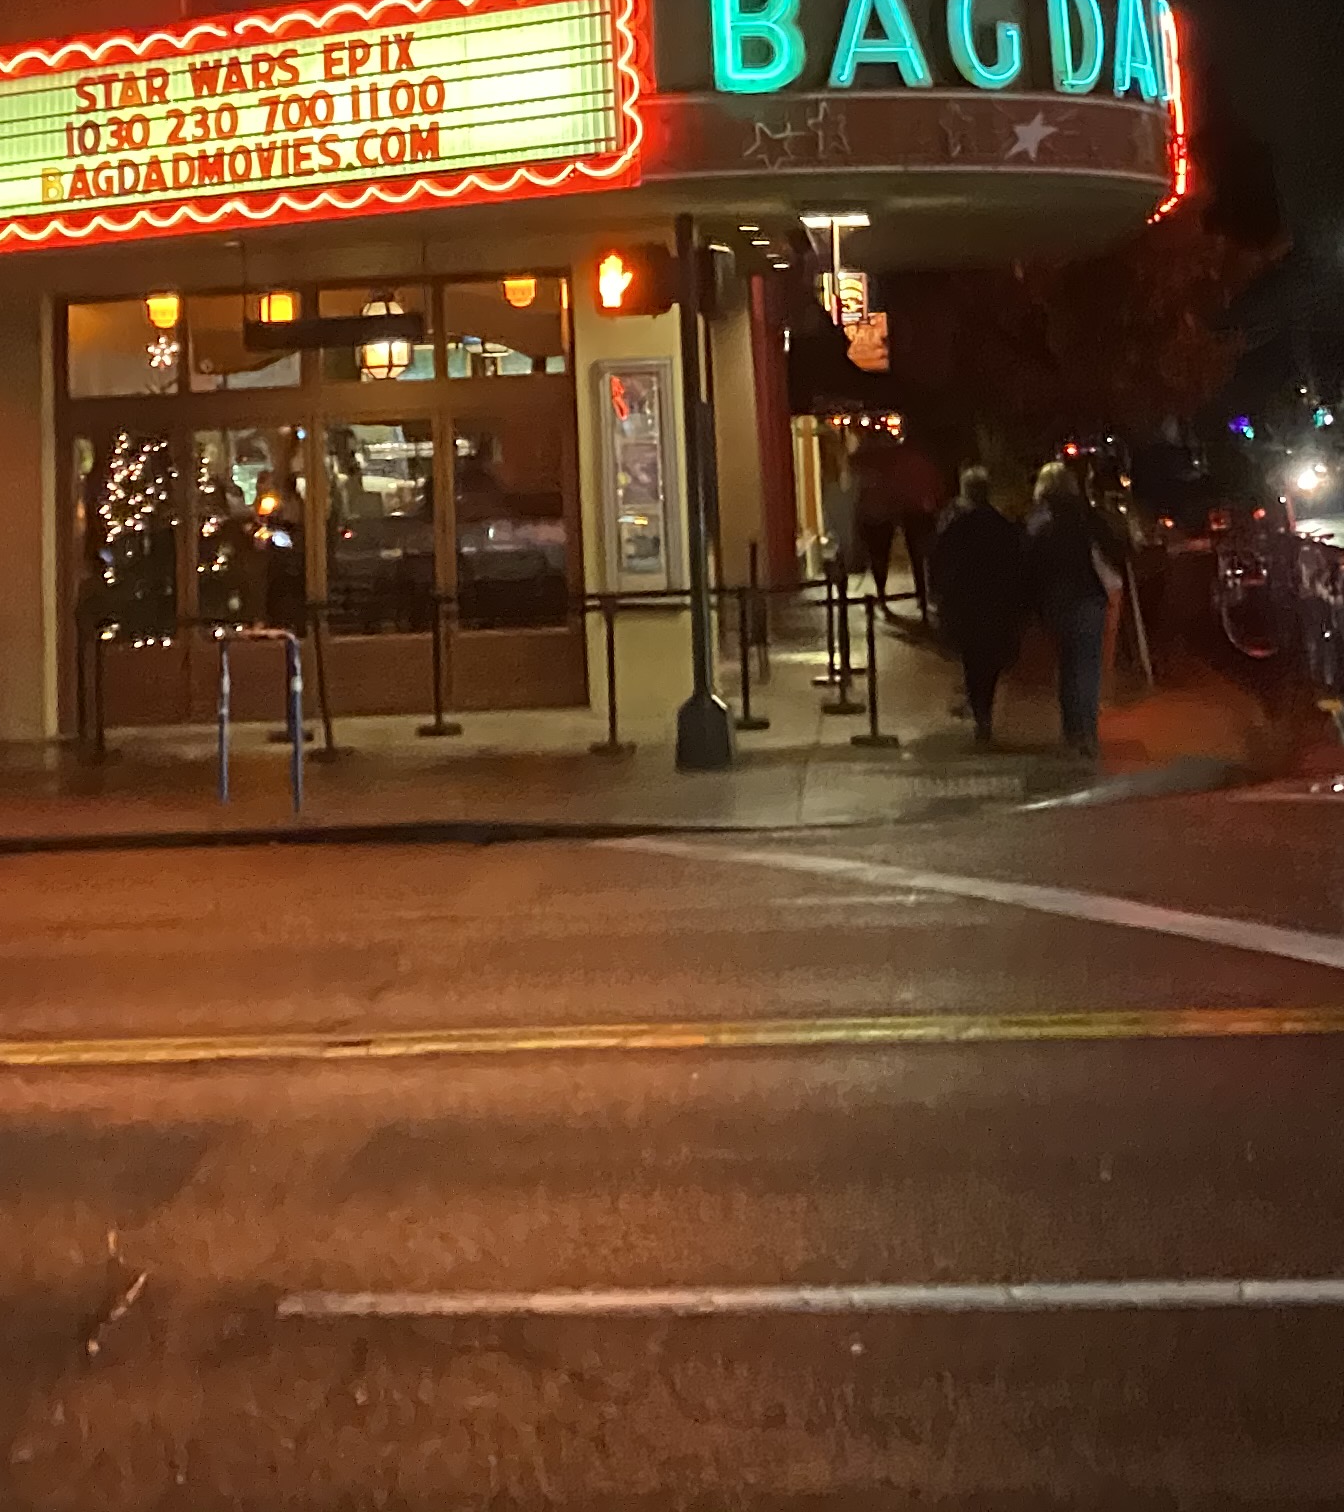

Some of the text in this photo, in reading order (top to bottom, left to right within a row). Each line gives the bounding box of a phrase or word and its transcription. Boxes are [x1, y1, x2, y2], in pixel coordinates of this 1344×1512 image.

[66, 76, 446, 157] 1030 230 700 1100
[75, 67, 170, 114] STAR
[188, 49, 300, 99] WARS
[41, 121, 440, 203] BAGDADMOVIES.COM
